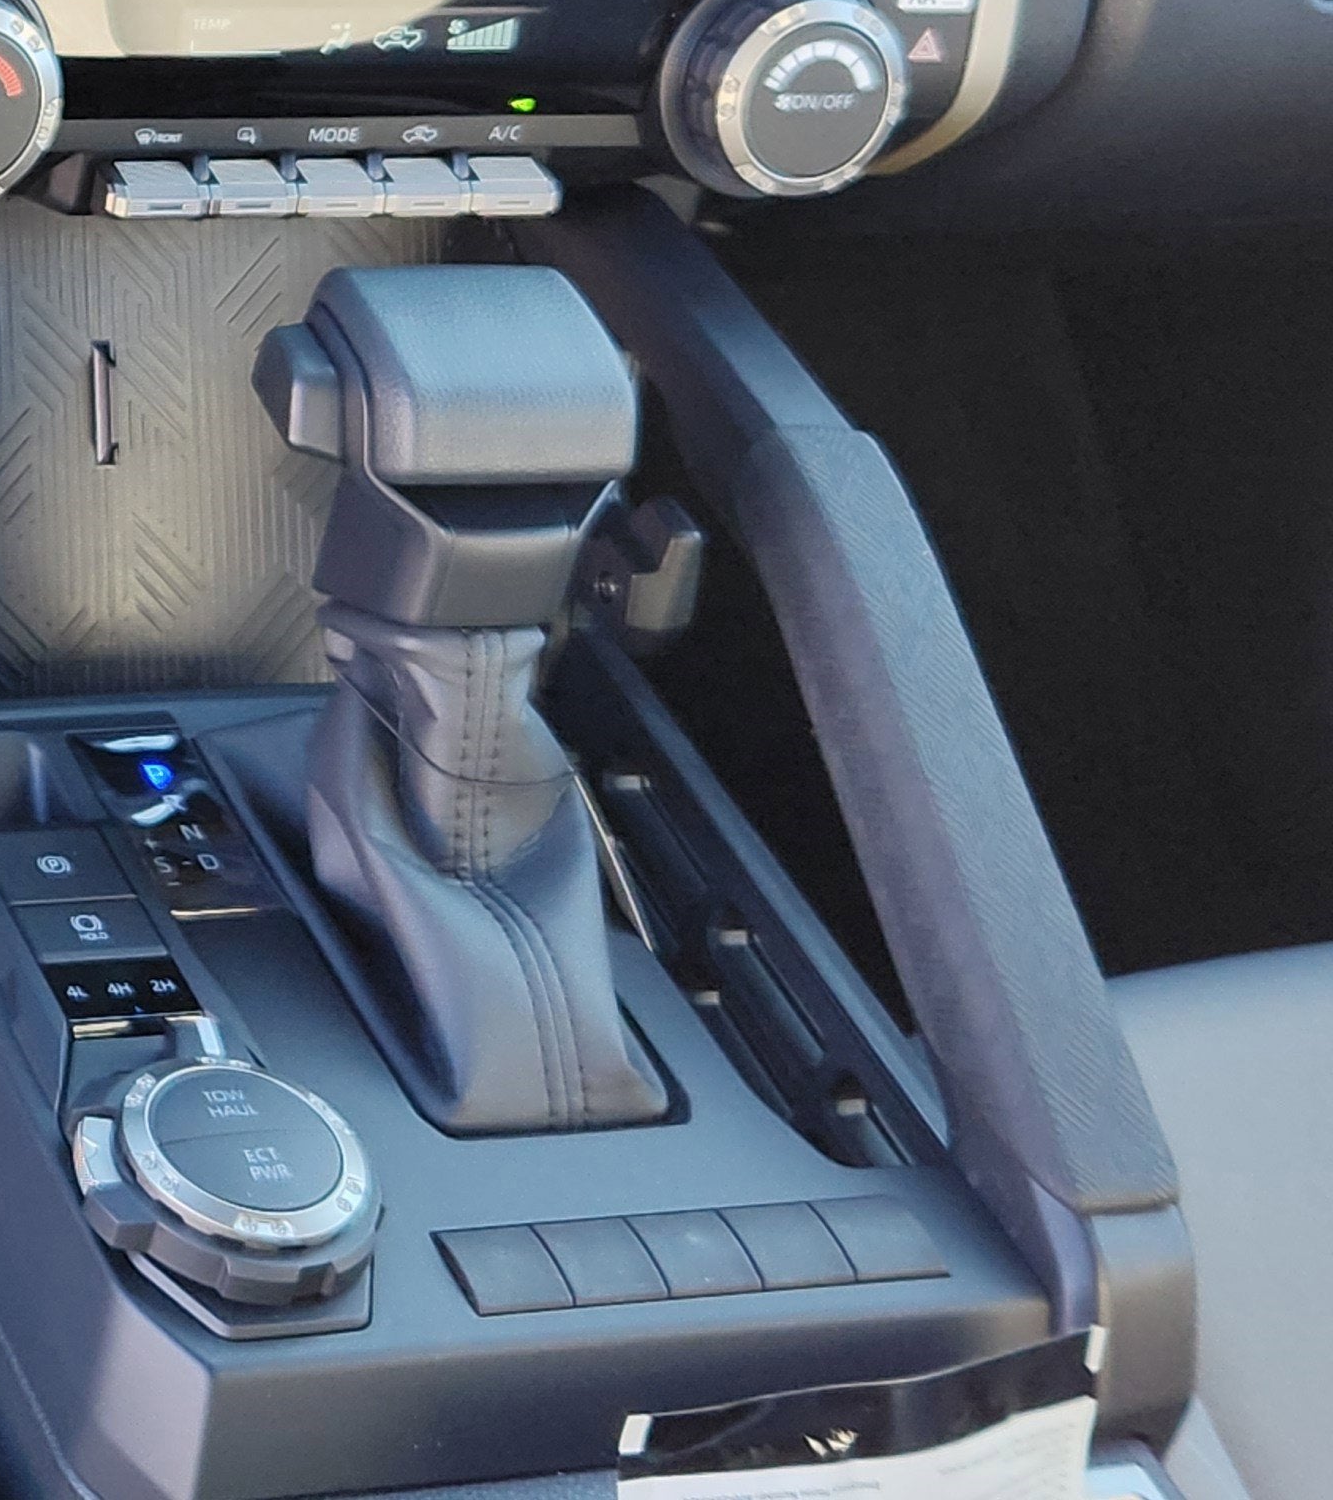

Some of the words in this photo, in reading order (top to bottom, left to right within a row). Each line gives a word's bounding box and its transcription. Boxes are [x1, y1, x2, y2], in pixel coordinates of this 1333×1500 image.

[191, 17, 232, 31] TEMP
[790, 93, 856, 111] ON/OFF
[307, 126, 361, 144] MODE
[488, 124, 523, 142] A/C
[179, 824, 206, 842] N
[153, 856, 173, 874] S
[197, 853, 222, 871] D
[79, 931, 110, 942] HOLD
[66, 983, 90, 998] 4L
[107, 981, 135, 996] 4H
[148, 978, 177, 994] 2H
[202, 1090, 246, 1103] TOW
[207, 1104, 259, 1119] HAUL
[242, 1146, 280, 1164] ECT
[249, 1163, 293, 1182] PWR
